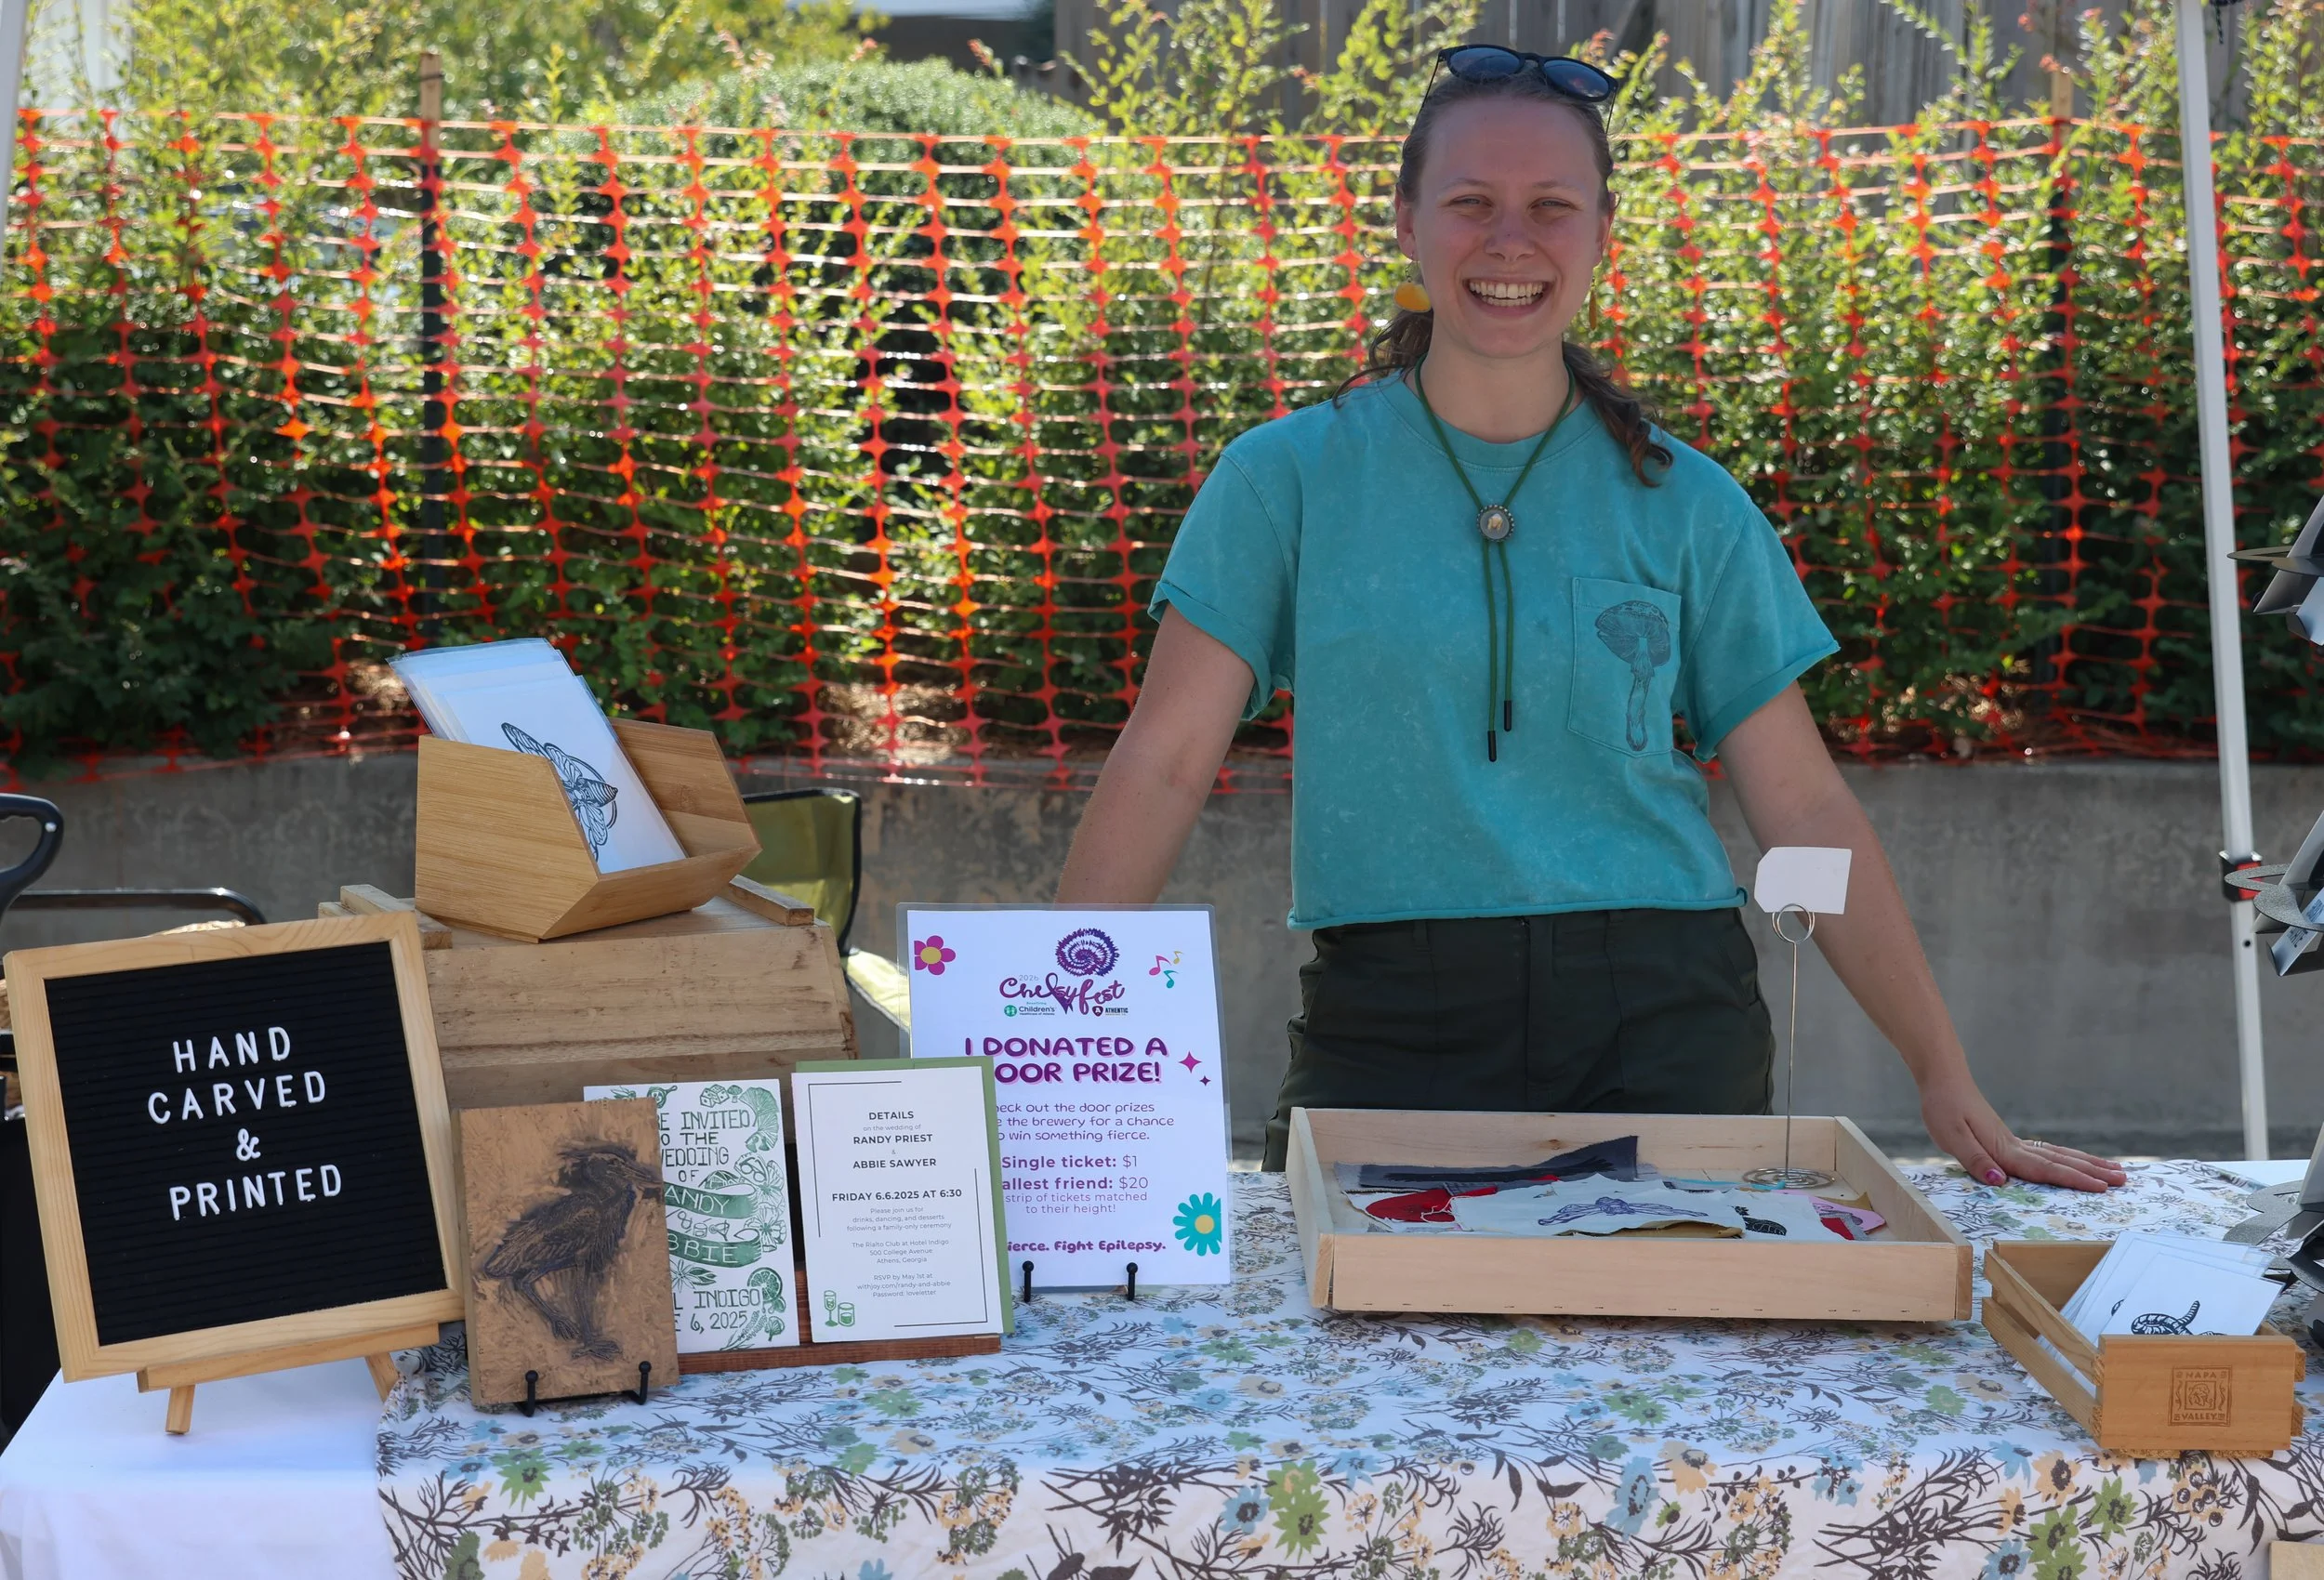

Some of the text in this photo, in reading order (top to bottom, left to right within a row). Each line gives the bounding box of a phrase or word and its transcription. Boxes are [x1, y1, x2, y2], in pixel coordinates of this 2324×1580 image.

[172, 1025, 292, 1073] HAND
[965, 1037, 1169, 1058] I DONATED A
[995, 1061, 1163, 1084] OOR PRIZE!
[147, 1071, 327, 1125] CARVED
[997, 1102, 1155, 1115] eck out the door prizes
[657, 1110, 750, 1131] E INVITED
[868, 1111, 915, 1121] DETAILS
[1007, 1117, 1028, 1126] the
[1032, 1117, 1086, 1128] brewery
[1089, 1116, 1112, 1126] for
[1116, 1118, 1123, 1126] a
[1127, 1116, 1174, 1126] chance
[660, 1132, 720, 1146] O THE
[853, 1134, 933, 1145] RANDY PRIEST
[998, 1130, 1150, 1143] o win something fierce.
[235, 1128, 261, 1162] &
[662, 1146, 729, 1167] EDDING
[852, 1158, 937, 1169] ABBIE SAWYER
[1002, 1154, 1138, 1171] Single ticket: $1
[679, 1169, 699, 1182] OF
[1002, 1175, 1149, 1191] allest friend: $20
[167, 1164, 342, 1221] PRINTED
[832, 1188, 962, 1202] FRIDAY 6.6.2025 AT 6:30
[1006, 1192, 1147, 1204] strip of tickets matched
[664, 1185, 730, 1215] ANDY
[1026, 1204, 1116, 1216] to their height!
[883, 1223, 918, 1231] family-only
[667, 1232, 738, 1264] BBIE
[928, 1238, 949, 1247] Indigo
[1008, 1242, 1050, 1252] ierce.
[1099, 1240, 1167, 1253] Epilepsy.
[693, 1288, 760, 1309] INDIGO
[690, 1313, 705, 1335] 6,
[710, 1310, 747, 1330] 2025
[2186, 1371, 2217, 1379] NAPA
